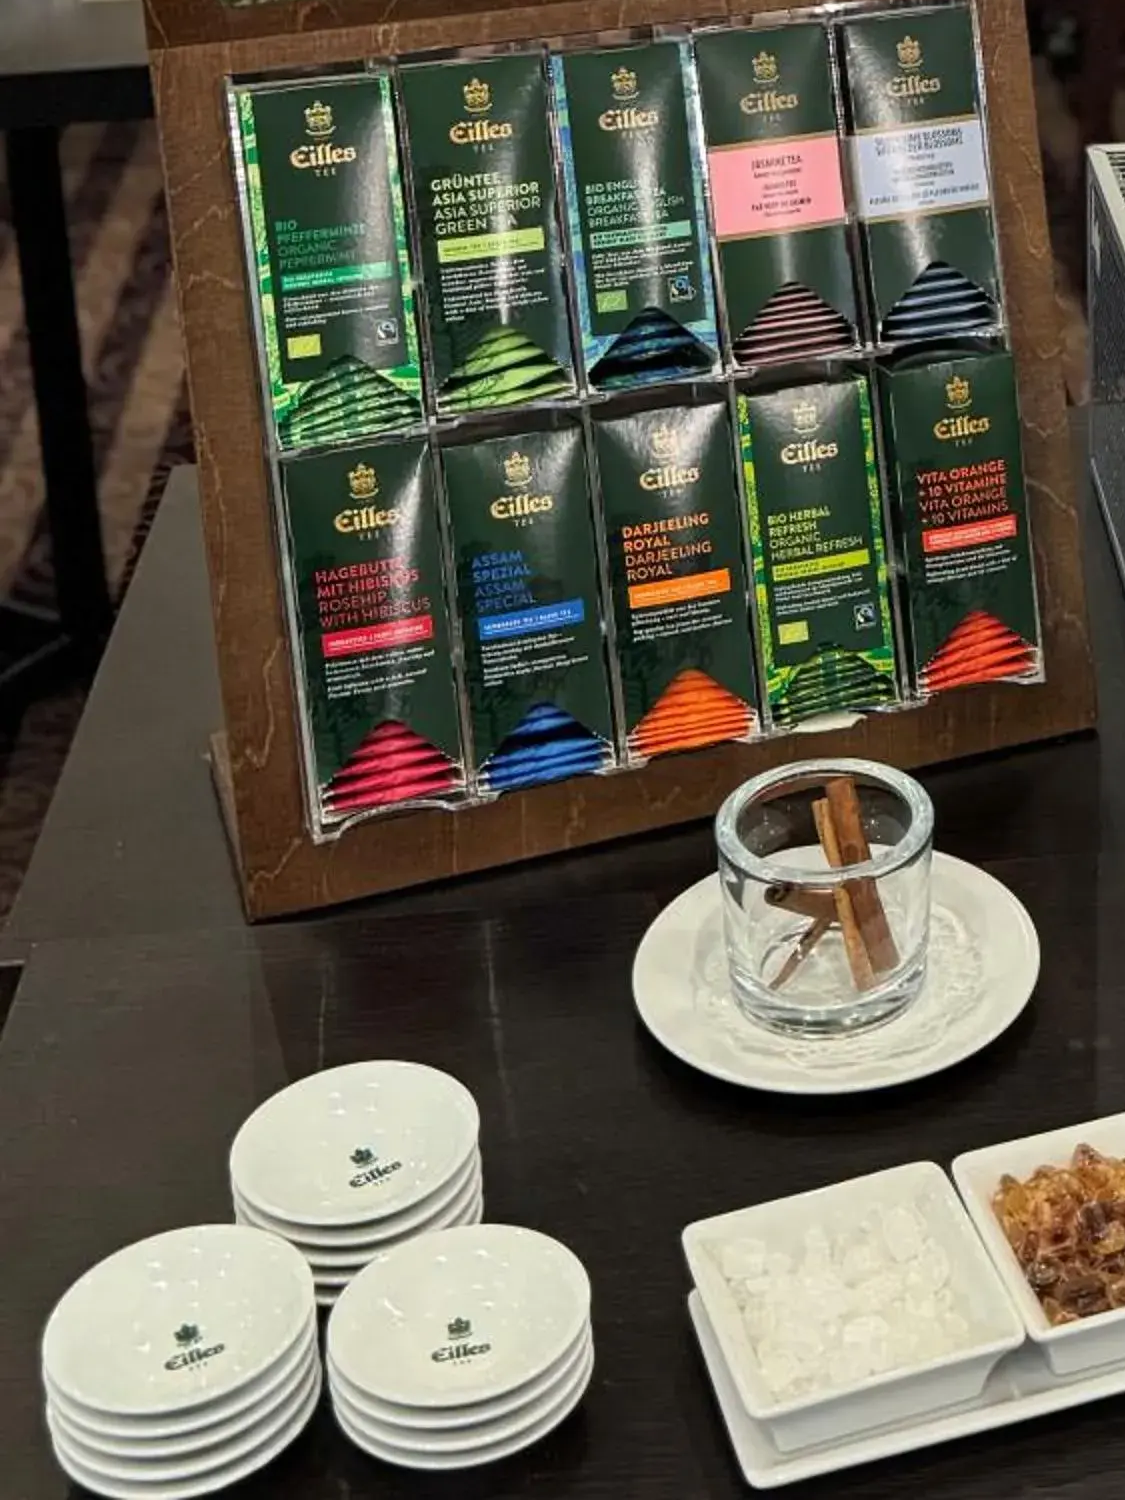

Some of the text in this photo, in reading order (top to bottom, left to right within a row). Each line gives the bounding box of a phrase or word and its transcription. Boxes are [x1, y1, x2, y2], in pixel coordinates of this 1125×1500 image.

[886, 75, 941, 97] Eilles
[739, 90, 799, 114] Eilles
[598, 108, 659, 131] Eilles
[450, 119, 513, 145] Eilles
[290, 143, 357, 168] Eilles
[431, 172, 501, 191] GRÜNTEE
[432, 181, 540, 207] ASIA SUPERIOR
[434, 196, 541, 221] ASIA SUPERIOR
[274, 220, 298, 233] BIO
[436, 217, 488, 235] GREEN
[933, 415, 991, 440] Eilles
[781, 441, 839, 464] Eilles
[639, 466, 700, 490] Eilles
[917, 459, 1006, 485] VITA ORANGE
[928, 485, 942, 498] 10
[944, 472, 1007, 494] VITAMINE
[490, 494, 553, 519] Eilles
[919, 485, 1006, 513] VITA ORANGE
[334, 505, 400, 533] Eilles
[767, 506, 831, 526] BIO HERBAL
[931, 511, 945, 525] 10
[949, 500, 1009, 523] VITAMINS
[622, 512, 710, 539] DARJEELING
[768, 521, 817, 537] REFRESH
[624, 535, 671, 553] ROYAL
[769, 532, 821, 549] ORGANIC
[771, 535, 863, 561] HERBAL REFRESH
[472, 550, 523, 569] ASSAM
[625, 541, 712, 567] DARJEELING
[473, 565, 532, 583] SPEZIAL
[627, 563, 673, 581] ROYAL
[317, 583, 344, 599] MIT
[319, 591, 388, 613] ROSEHIP
[320, 596, 431, 629] WITH HIBISCUS
[476, 595, 536, 613] SPECIAL
